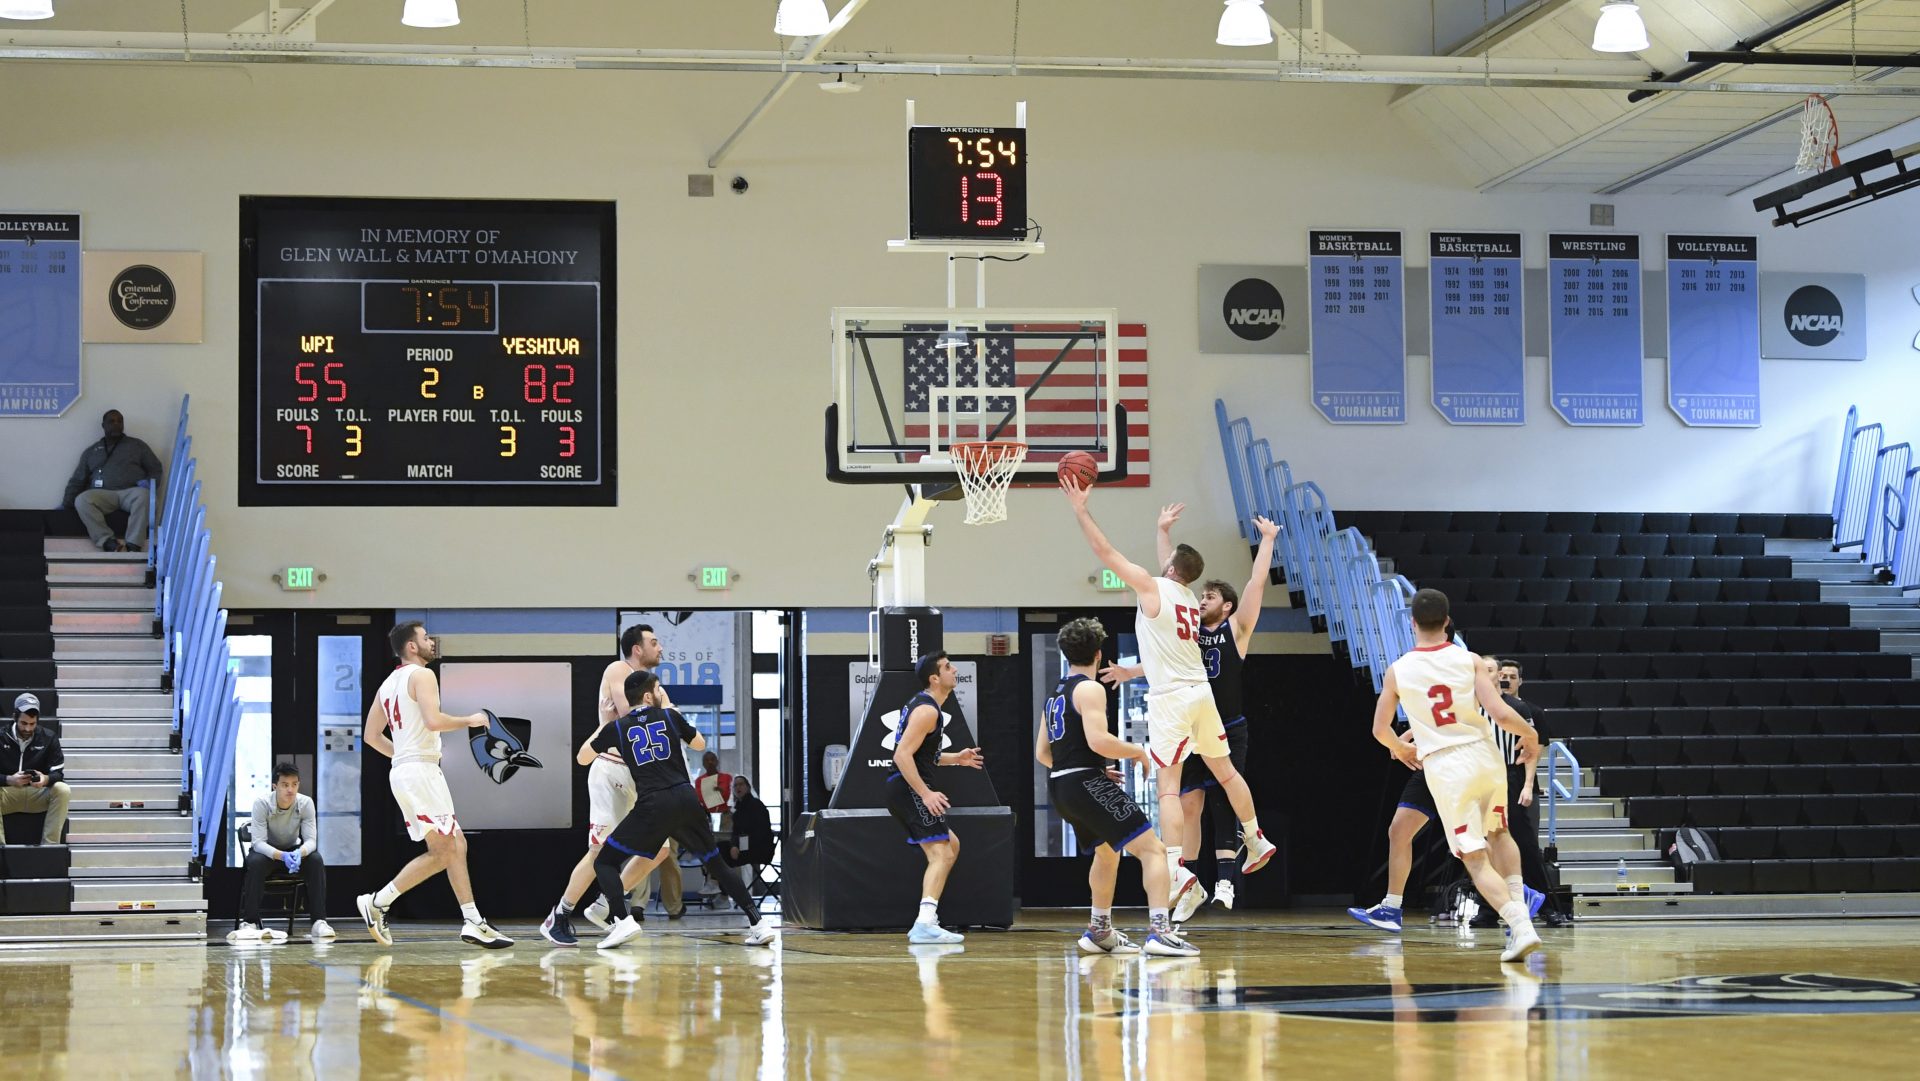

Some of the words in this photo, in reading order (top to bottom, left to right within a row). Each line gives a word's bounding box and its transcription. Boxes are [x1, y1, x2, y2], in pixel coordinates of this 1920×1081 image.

[948, 137, 1016, 168] 7:54
[961, 173, 1002, 226] 13
[0, 222, 69, 231] OLLEYBALL
[361, 229, 380, 242] IN
[386, 229, 471, 243] MEMORY
[476, 230, 500, 244] OF
[1319, 242, 1392, 251] BASKETBALL
[1440, 244, 1512, 253] BASKETBALL
[1562, 242, 1626, 251] WRESTLING
[1677, 243, 1747, 252] VOLLEYBALL
[280, 248, 331, 262] GLEN
[336, 248, 391, 263] WALL
[396, 249, 410, 263] &
[415, 249, 470, 263] MATT
[475, 250, 578, 264] O'MAHONY
[117, 280, 161, 298] Centennial
[1374, 292, 1389, 300] 2011
[121, 293, 169, 311] Conference
[402, 287, 489, 326] 7:54
[1229, 308, 1284, 325] NCAA
[1790, 314, 1844, 331] NCAA
[301, 336, 334, 353] WPI
[502, 338, 580, 355] YESHIVA
[406, 348, 453, 361] PERIOD
[295, 363, 347, 402] 55
[421, 368, 439, 398] 2
[524, 364, 575, 403] 82
[473, 385, 484, 400] B
[1453, 396, 1500, 405] DIVISION
[1572, 397, 1618, 407] DIVISION
[276, 408, 319, 421] FOULS
[335, 409, 371, 421] T.O.L.
[388, 409, 438, 422] PLAYER
[442, 410, 476, 422] FOUL
[490, 410, 525, 422] T.O.L.
[541, 410, 582, 423] FOULS
[1334, 406, 1399, 417] TOURNAMENT
[1454, 407, 1519, 418] TOURNAMENT
[1573, 408, 1638, 419] TOURNAMENT
[1691, 408, 1755, 420] TOURNAMENT
[296, 425, 312, 454] 7
[346, 425, 361, 456] 3
[500, 426, 516, 457] 3
[560, 426, 575, 457] 3
[276, 464, 319, 478] SCORE
[407, 465, 453, 478] MATCH
[540, 465, 582, 478] SCORE
[287, 567, 313, 587] EXIT
[703, 567, 727, 587] EXIT
[1175, 604, 1200, 644] 55
[695, 652, 714, 660] OF
[383, 694, 403, 732] 14
[1427, 684, 1457, 728] 2
[627, 720, 672, 766] 25
[1082, 773, 1139, 822] MACS
